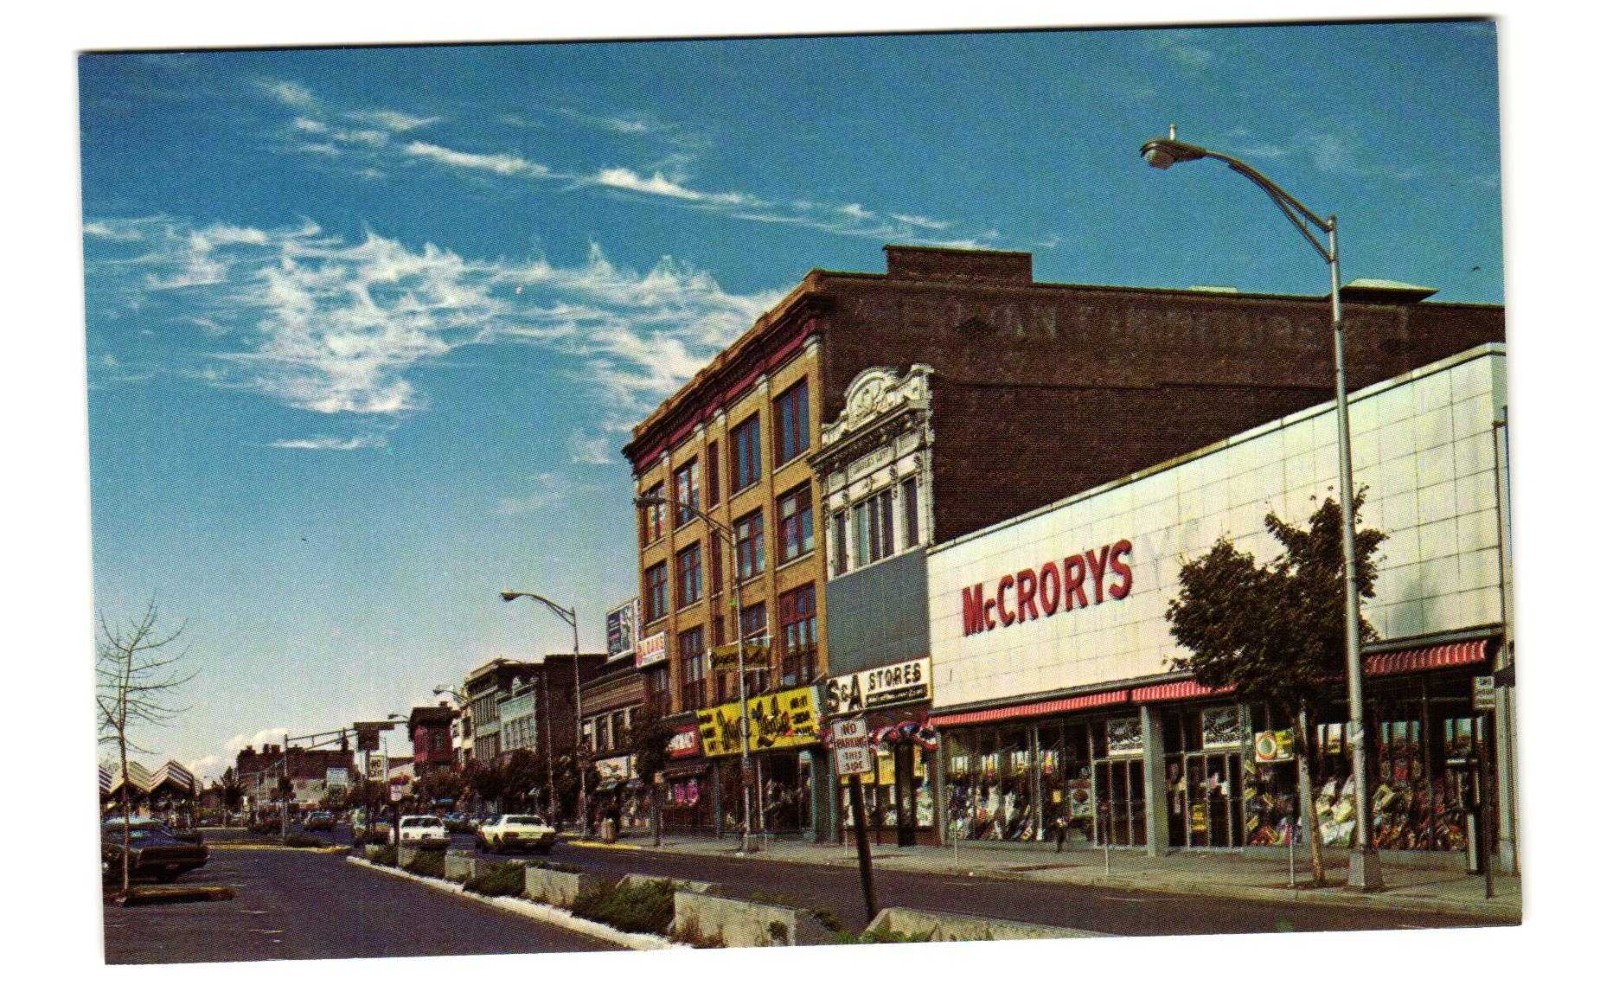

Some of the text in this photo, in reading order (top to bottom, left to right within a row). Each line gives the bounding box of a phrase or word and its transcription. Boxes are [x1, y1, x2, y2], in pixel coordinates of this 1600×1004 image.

[962, 539, 1133, 636] McCRORYS
[825, 674, 862, 713] S&A
[867, 662, 922, 691] STORES
[842, 723, 857, 735] NO
[844, 751, 862, 760] THIS
[845, 760, 863, 771] SIDE
